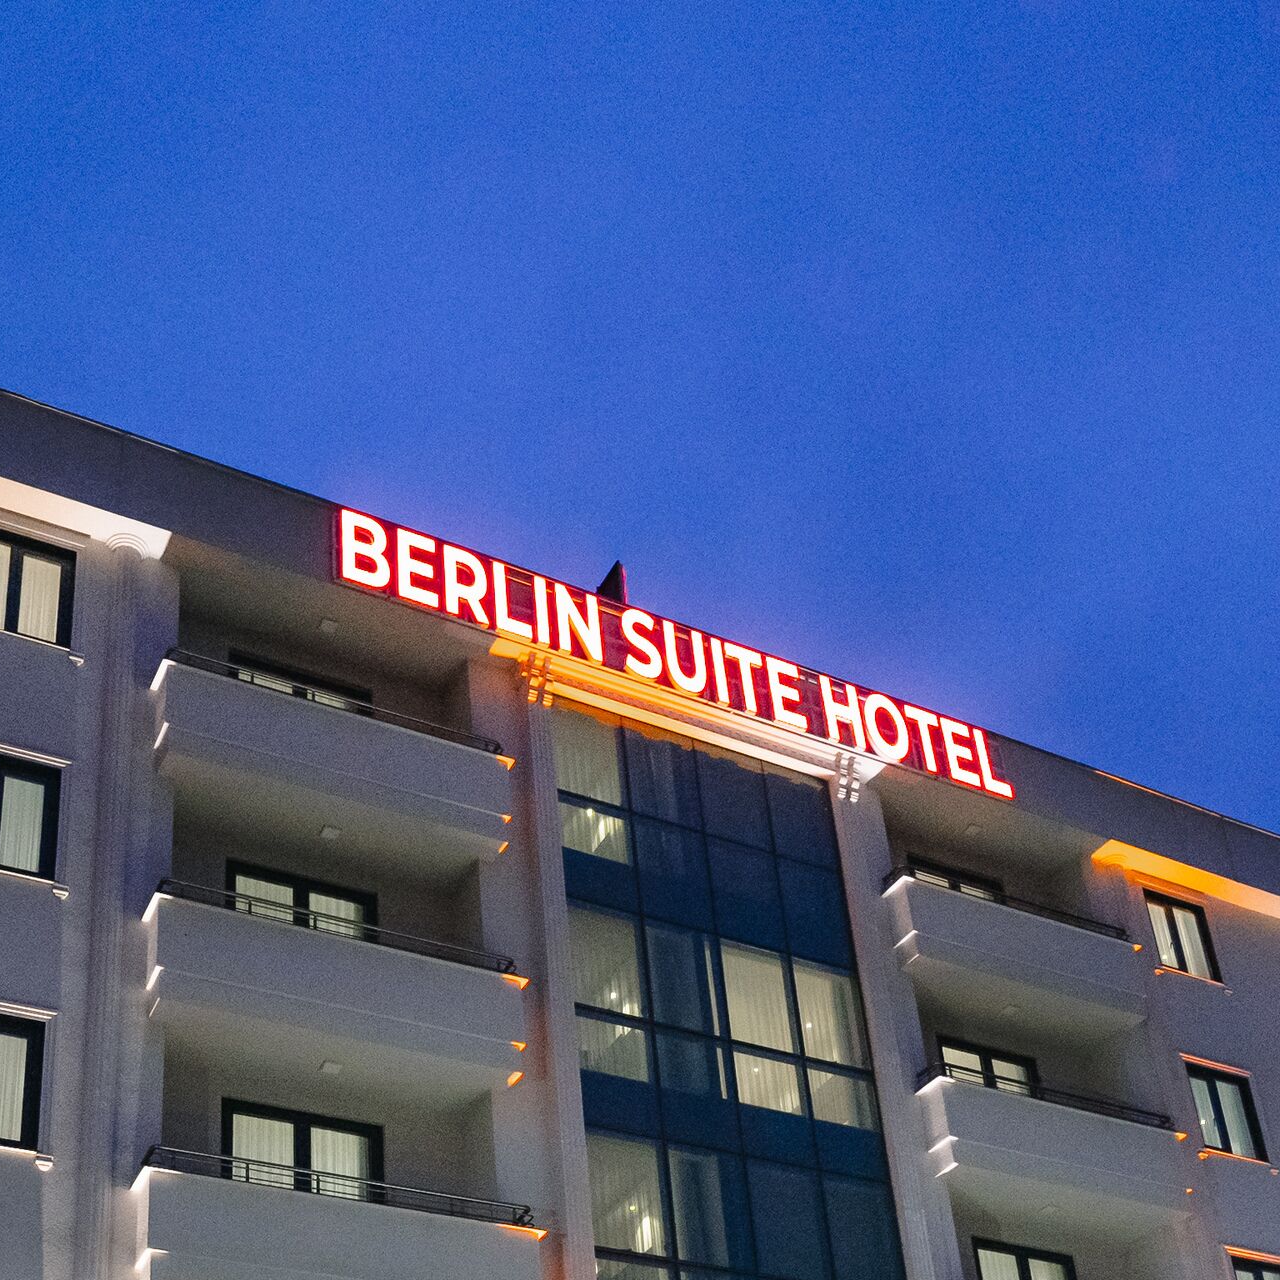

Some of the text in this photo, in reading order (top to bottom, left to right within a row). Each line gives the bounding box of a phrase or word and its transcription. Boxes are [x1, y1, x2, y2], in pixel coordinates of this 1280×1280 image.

[337, 508, 1015, 799] BERLIN SUITE HOTEL
